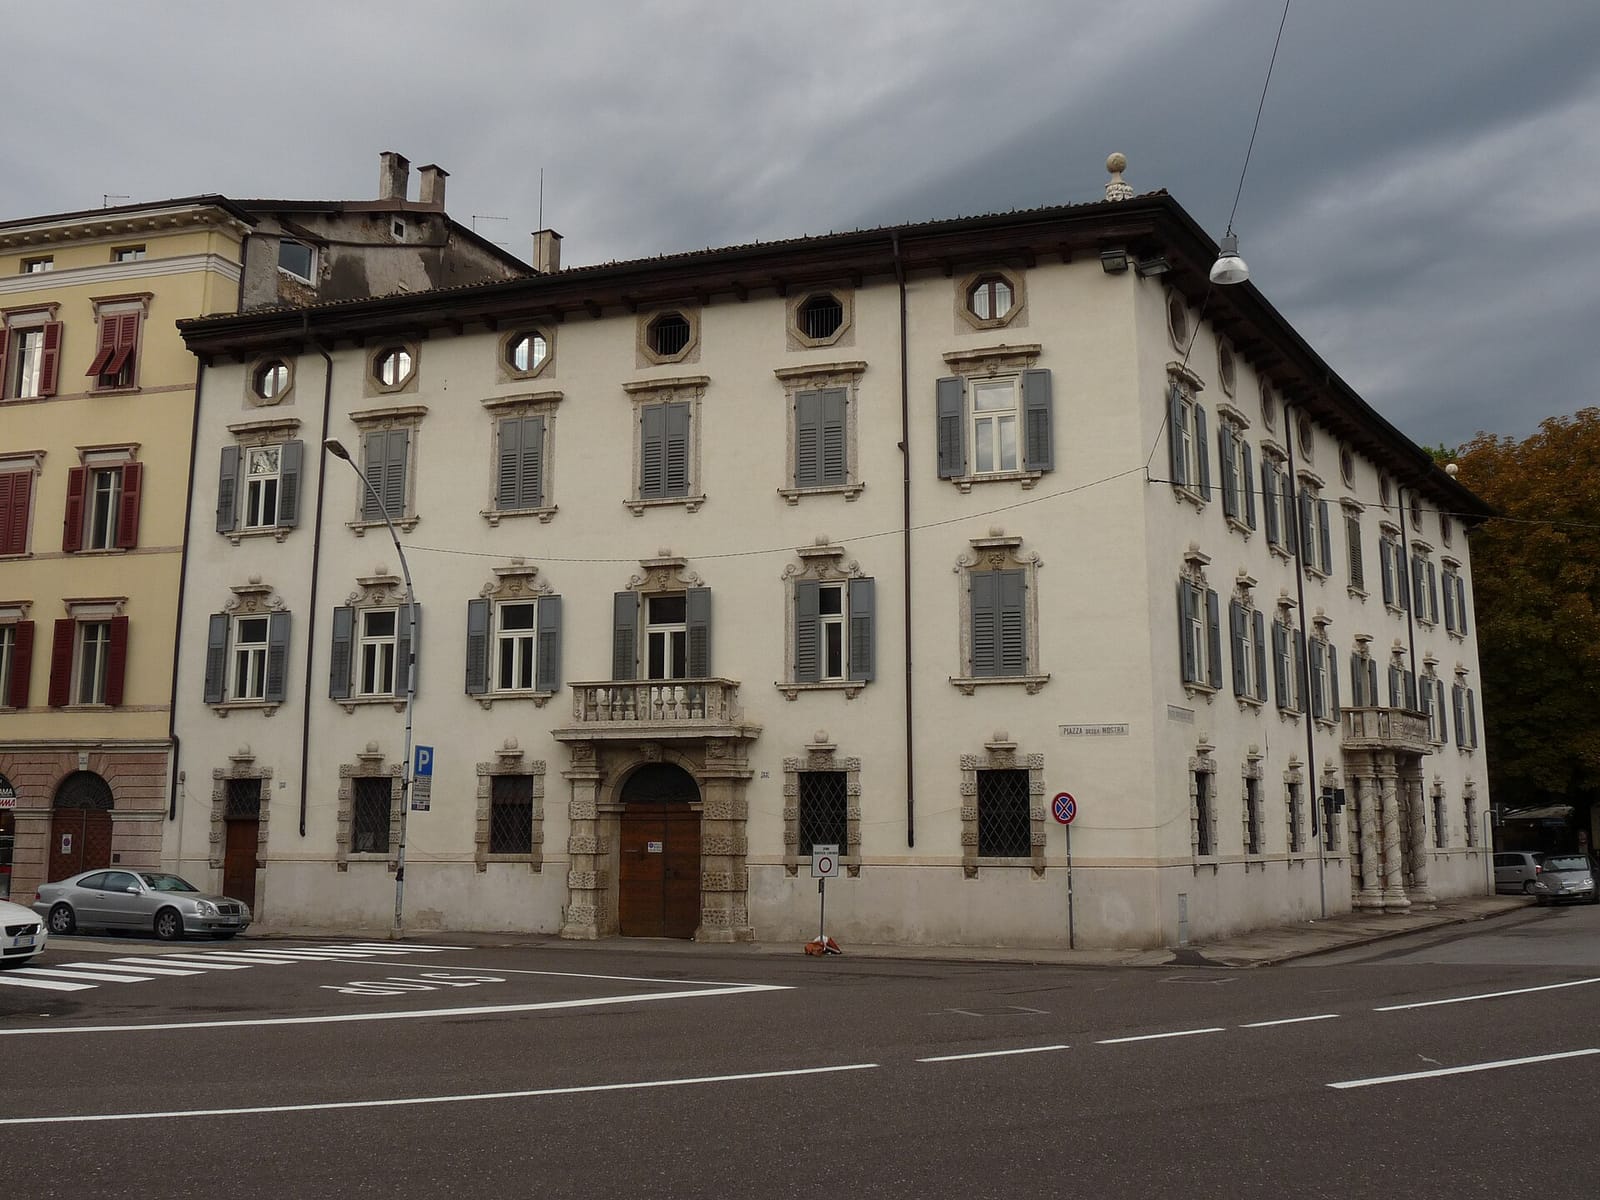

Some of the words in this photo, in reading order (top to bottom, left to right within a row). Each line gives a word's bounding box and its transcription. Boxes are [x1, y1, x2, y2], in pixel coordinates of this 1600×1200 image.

[1063, 727, 1083, 736] PIAZZA
[1102, 726, 1125, 734] MOSTRA
[418, 749, 430, 771] P
[320, 973, 507, 996] STOP
